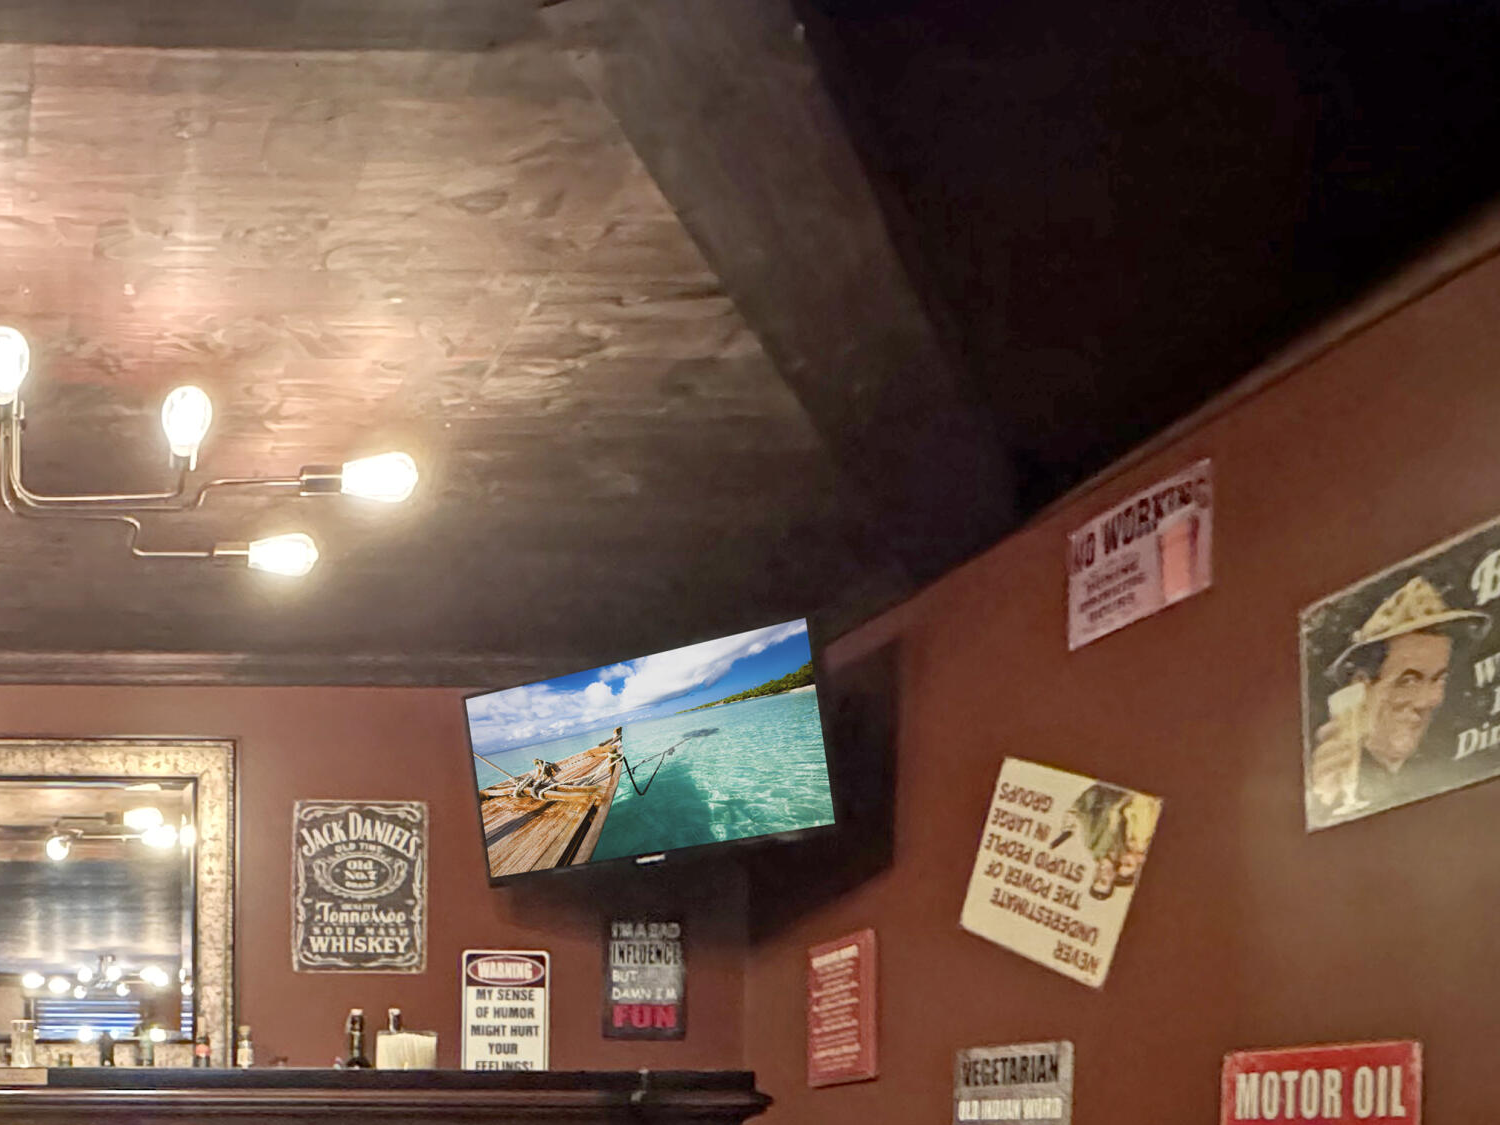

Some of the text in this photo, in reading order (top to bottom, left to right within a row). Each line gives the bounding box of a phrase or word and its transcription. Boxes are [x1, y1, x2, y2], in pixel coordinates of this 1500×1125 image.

[998, 782, 1054, 814] GROUPS
[300, 811, 422, 861] JACK DANIEL'S
[991, 807, 1052, 843] IN LARGE
[346, 859, 374, 870] Old
[984, 832, 1087, 883] STUPID PEOPLE
[984, 859, 1083, 911] THE POWER OF
[315, 902, 407, 924] Tennessee
[990, 888, 1100, 946] UNDERESTIMATE
[312, 926, 410, 937] SOUR MASH
[308, 936, 412, 954] WHISKEY
[611, 943, 682, 965] INFLUENCE
[1053, 940, 1102, 976] NEVER
[477, 961, 533, 980] WARNING
[612, 969, 638, 982] BUT
[476, 988, 535, 1001] MY SENSE
[612, 987, 652, 1001] DAMN
[475, 1006, 535, 1020] OF HUMOR
[612, 1003, 677, 1029] FUN
[470, 1024, 541, 1037] MIGHT HURT
[488, 1043, 519, 1055] YOUR
[961, 1053, 1059, 1088] VEGETARIAN
[1235, 1064, 1407, 1121] MOTOR OIL
